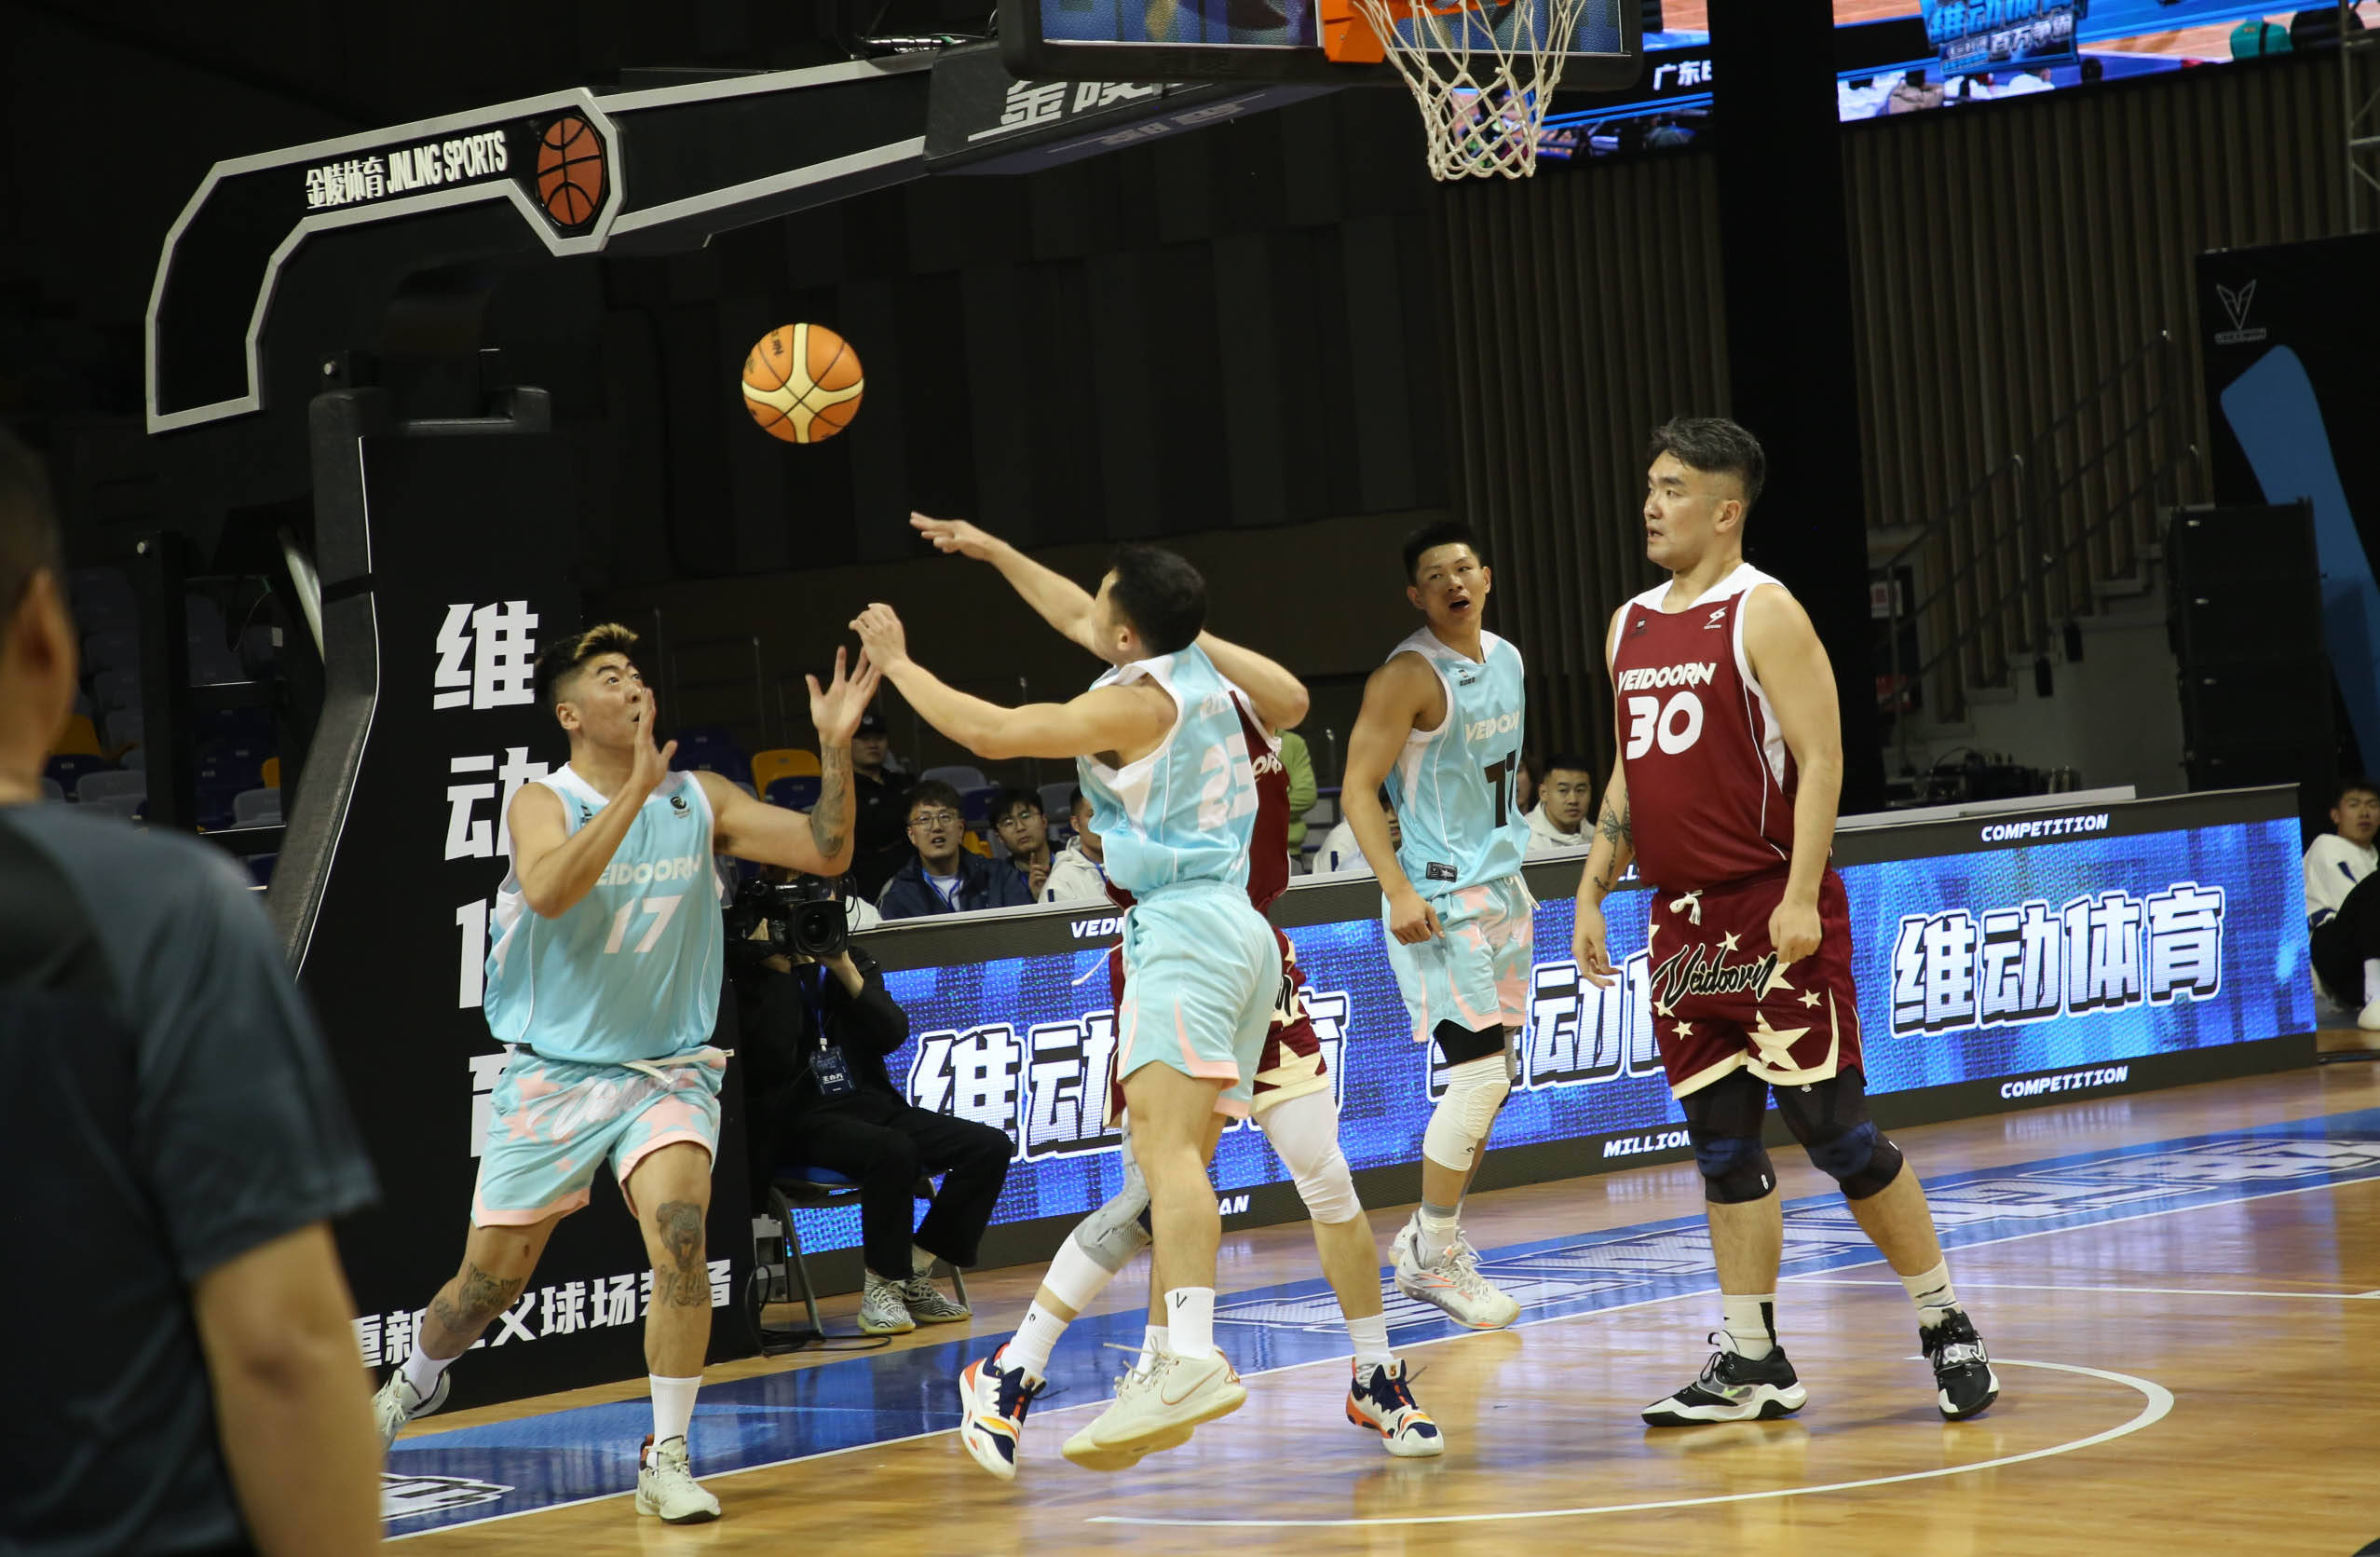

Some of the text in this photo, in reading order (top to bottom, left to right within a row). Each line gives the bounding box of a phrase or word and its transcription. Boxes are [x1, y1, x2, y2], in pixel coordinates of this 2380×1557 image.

[306, 130, 508, 210] 金陵体育 JINLING SPORTS
[1617, 662, 1718, 698] VEIDOORN
[1625, 690, 1705, 760] 30
[1980, 813, 2110, 842] COMPETITION
[432, 600, 550, 1158] 维动
[593, 853, 703, 886] EIDOORN
[603, 894, 684, 955] 17
[1892, 883, 2224, 1036] 维动体育
[2000, 1065, 2129, 1099] COMPETITION
